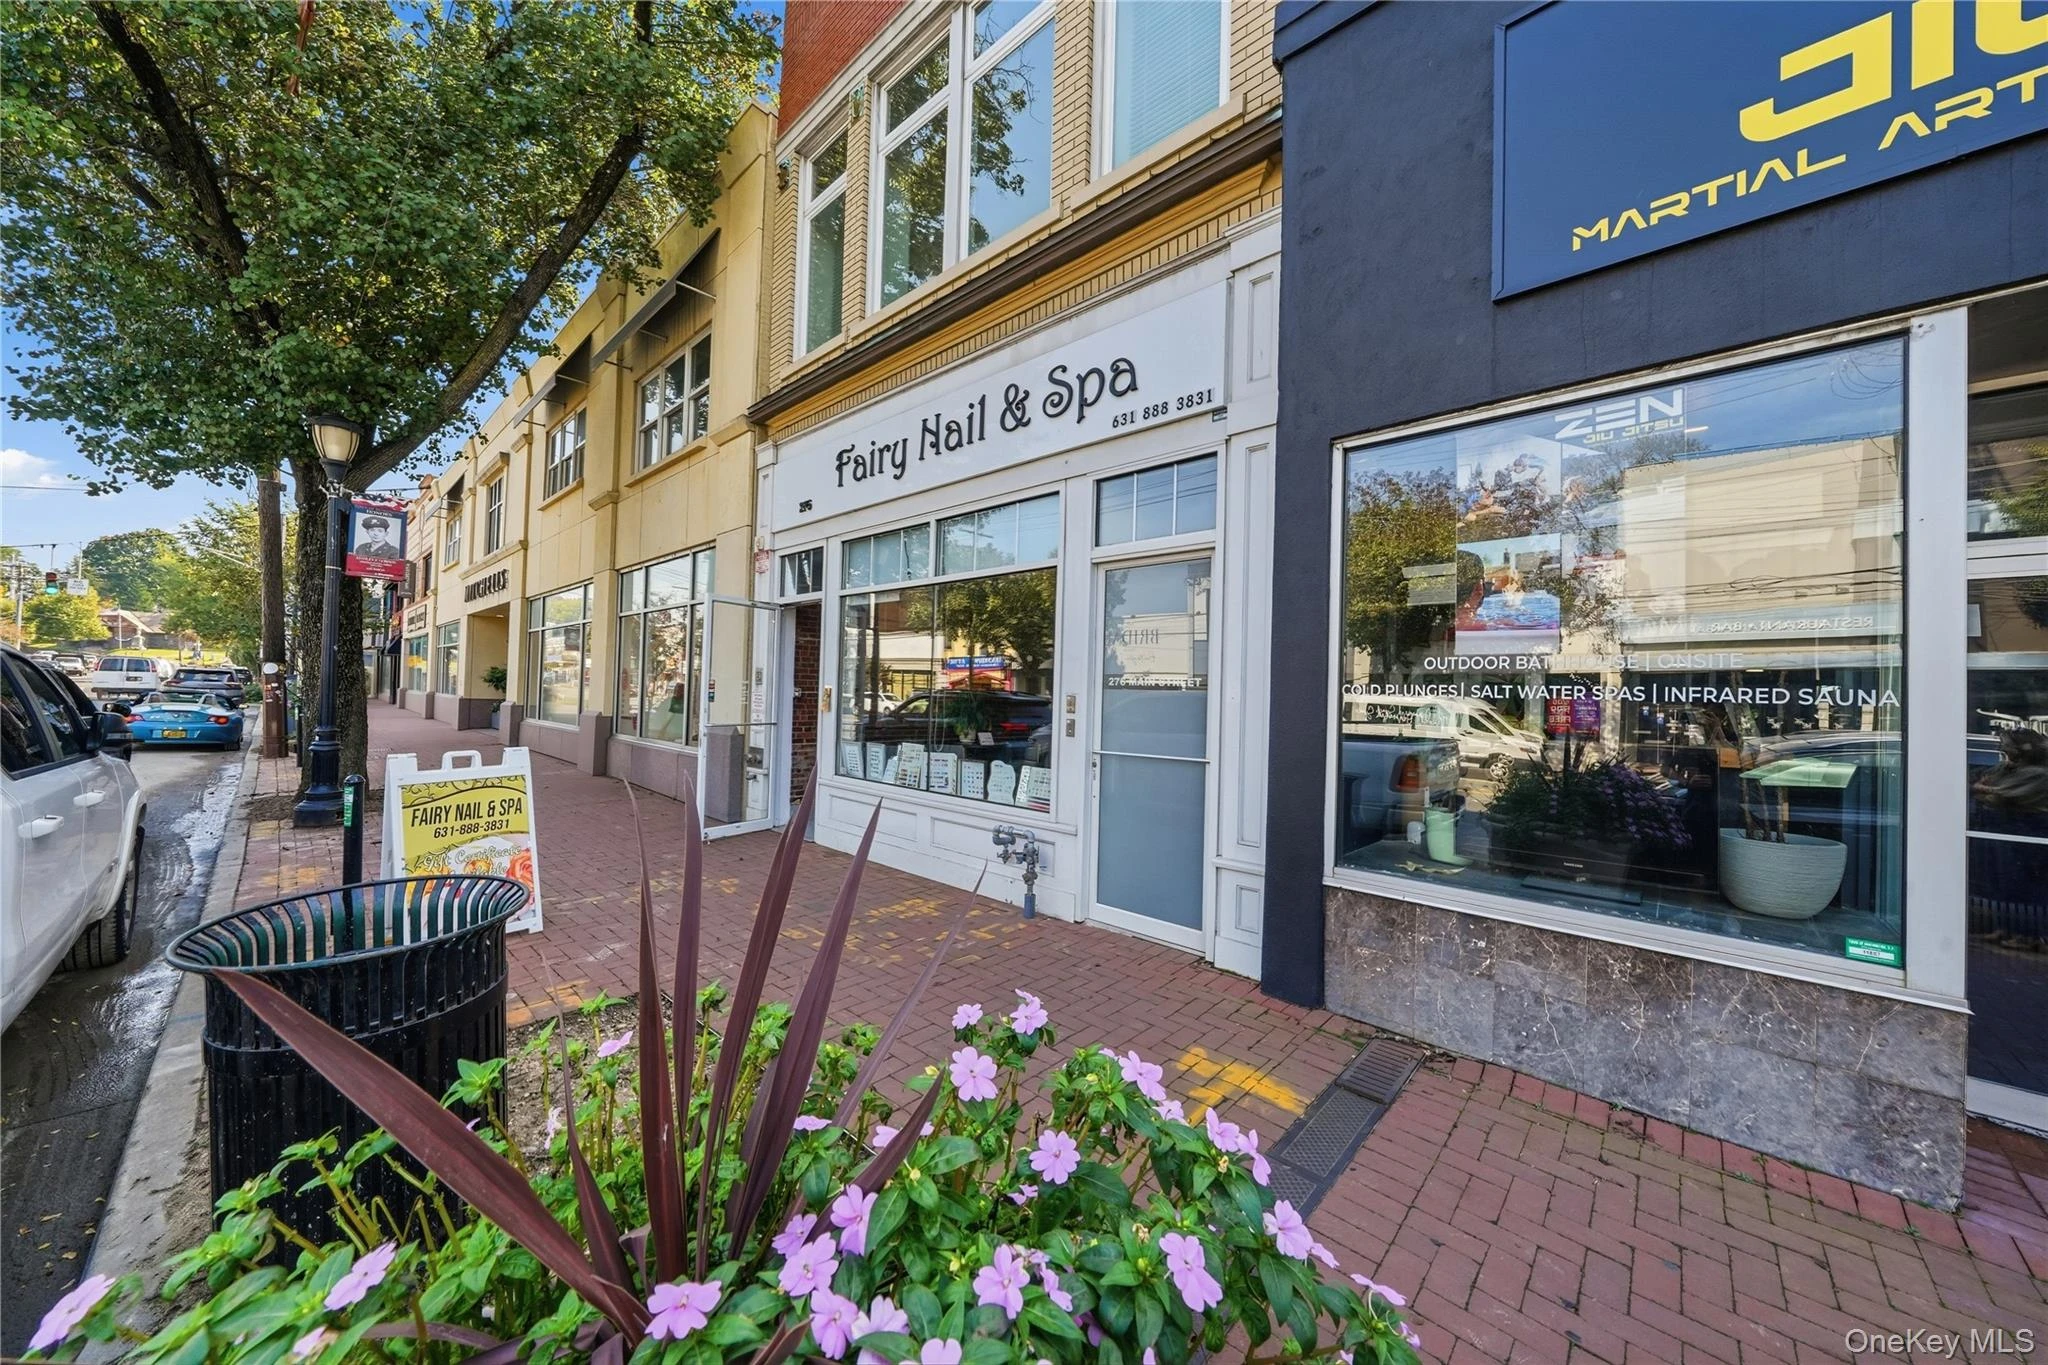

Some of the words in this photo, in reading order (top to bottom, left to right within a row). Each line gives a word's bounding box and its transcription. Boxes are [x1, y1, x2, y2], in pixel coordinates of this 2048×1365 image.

[1572, 148, 1847, 252] MARTIAL
[835, 438, 908, 487] Fairy
[918, 393, 986, 461] Nail
[1000, 383, 1032, 433] &
[1042, 357, 1139, 425] Spa
[1111, 411, 1136, 429] 631
[1142, 401, 1169, 420] 888
[1176, 387, 1213, 411] 3831
[1554, 388, 1683, 440] ZEN
[1583, 431, 1613, 444] JIU
[1622, 416, 1684, 438] JITSU
[1423, 656, 1510, 670] OUTDOOR
[1657, 653, 1744, 669] ONSITE
[1128, 678, 1155, 687] MAIN
[1157, 677, 1202, 687] STREET
[1342, 684, 1381, 696] COLD
[1385, 684, 1458, 697] PLUNGES
[1470, 684, 1512, 699] SALT
[1518, 685, 1586, 700] WATER
[1592, 685, 1646, 702] SPAS
[1665, 686, 1790, 705] INFRARED
[1798, 687, 1901, 707] SAUNA
[411, 804, 452, 827] FAIRY
[454, 802, 483, 821] NAIL
[487, 800, 496, 817] &
[499, 797, 523, 816] SPA
[433, 819, 510, 839] 631-888-3831
[454, 845, 522, 864] Certificate
